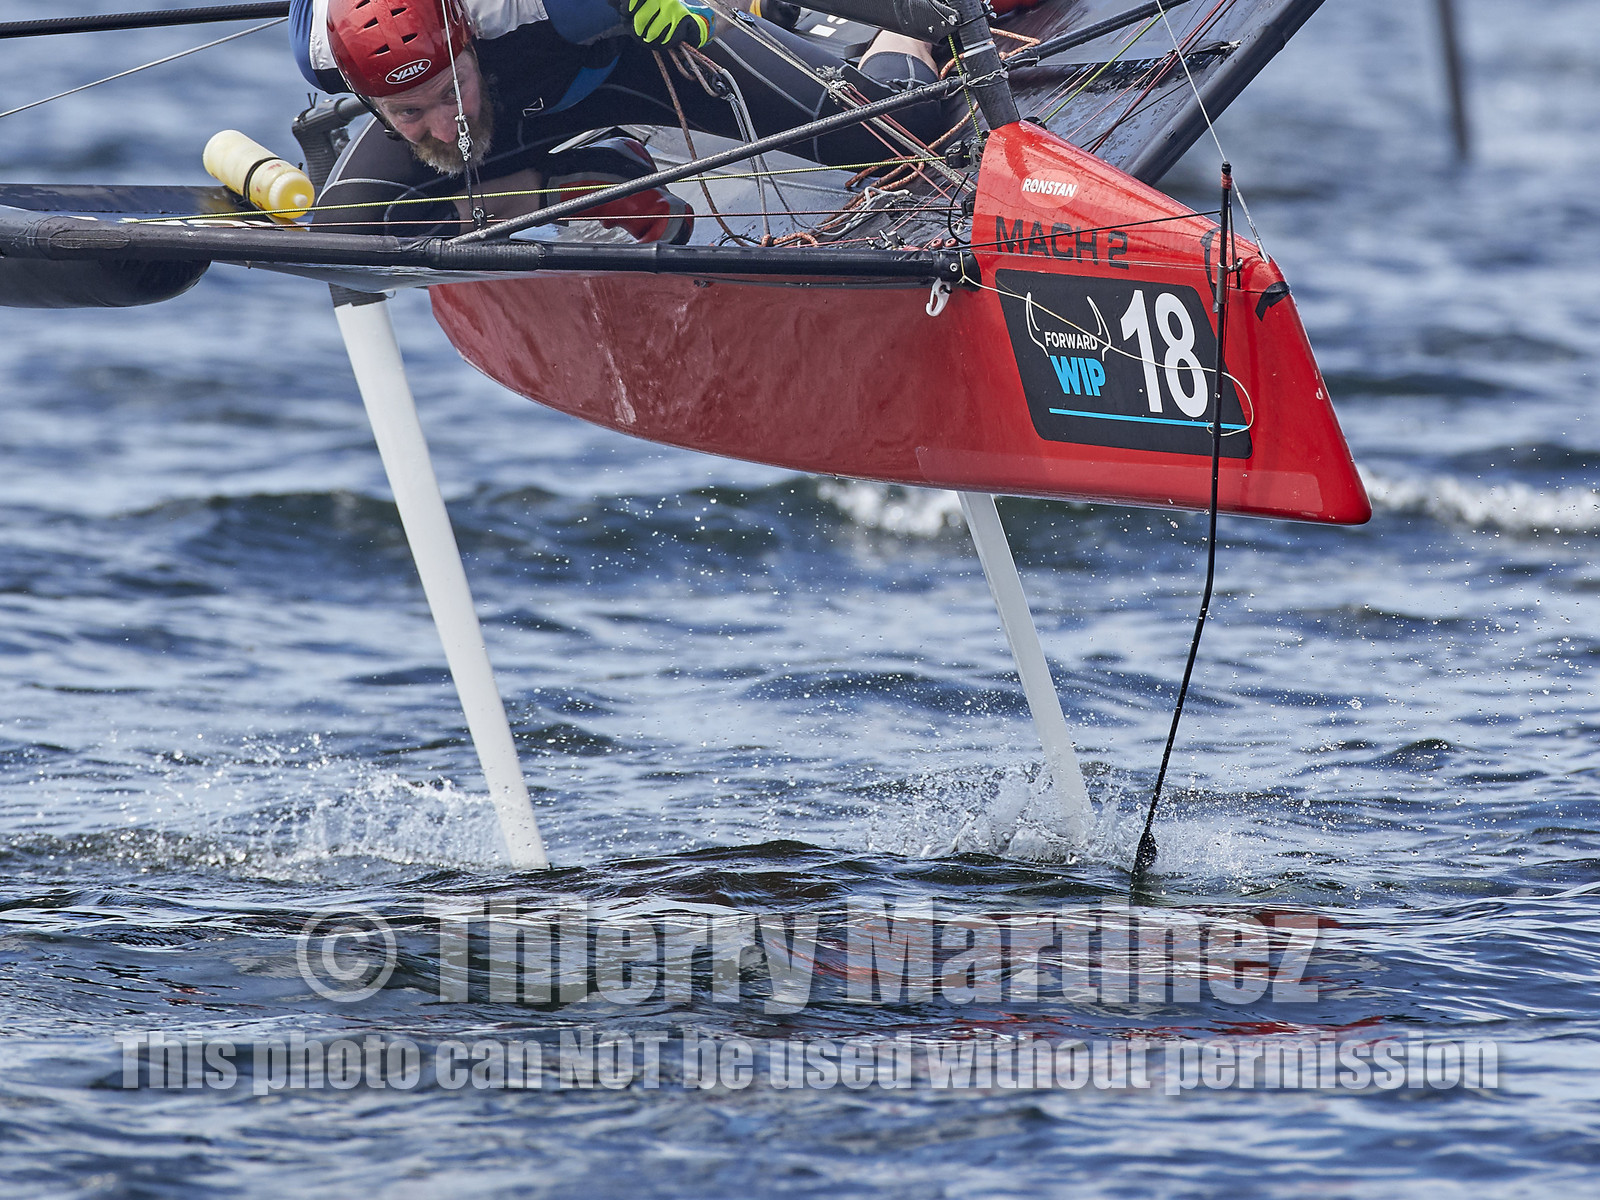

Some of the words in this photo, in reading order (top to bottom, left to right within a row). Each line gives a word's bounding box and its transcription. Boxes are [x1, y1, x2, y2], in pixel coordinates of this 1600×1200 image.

[391, 61, 426, 81] YAK
[1021, 177, 1078, 197] RONSTAN
[995, 215, 1099, 266] MACH
[1107, 230, 1130, 270] 2
[1044, 331, 1098, 351] FORWARD
[1120, 289, 1209, 418] 18
[1050, 355, 1106, 397] WIP
